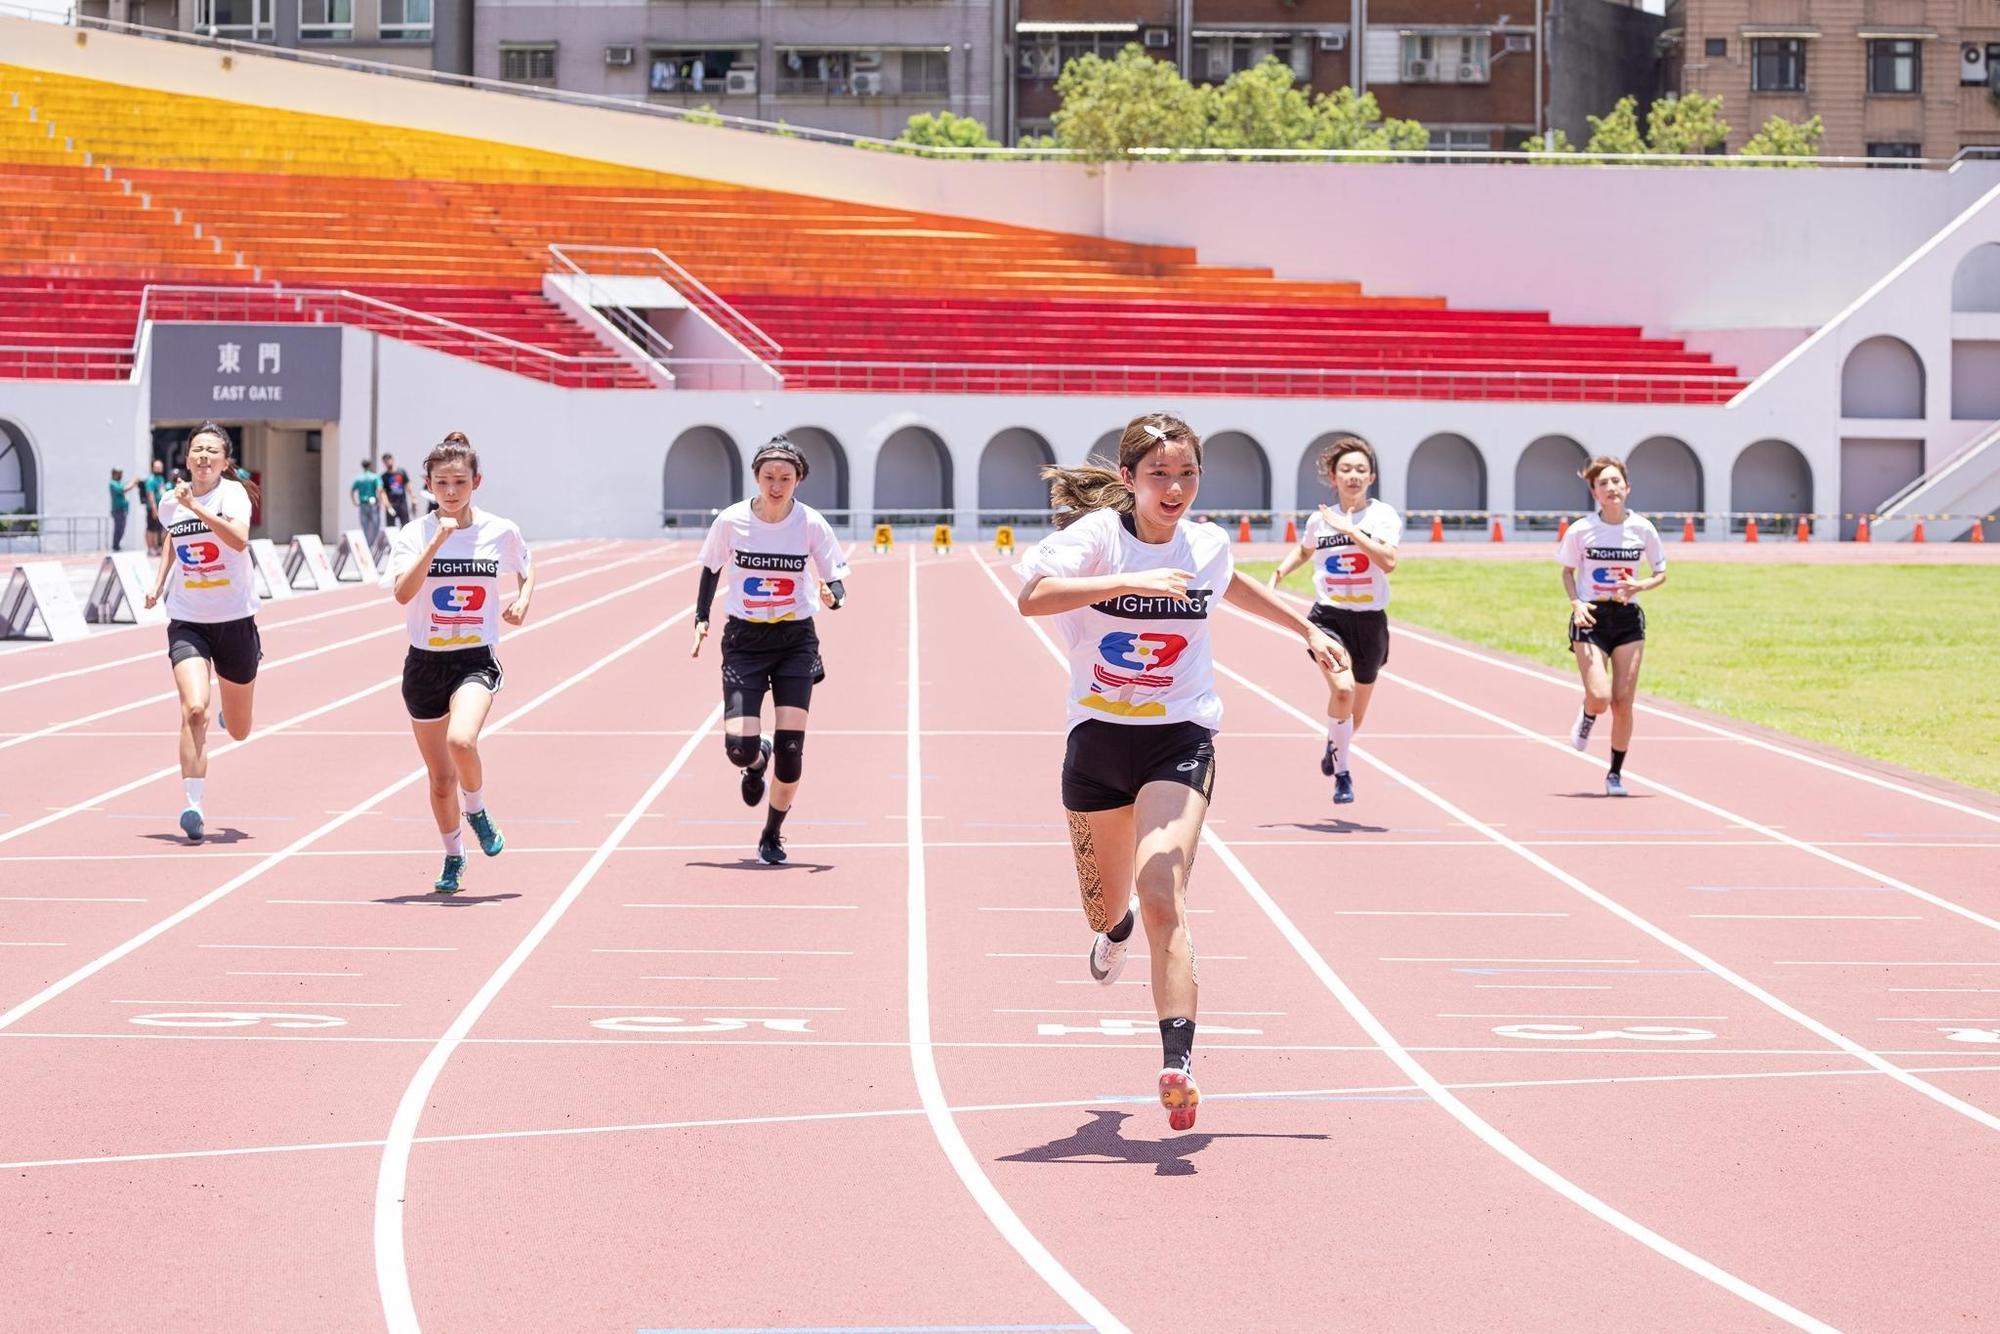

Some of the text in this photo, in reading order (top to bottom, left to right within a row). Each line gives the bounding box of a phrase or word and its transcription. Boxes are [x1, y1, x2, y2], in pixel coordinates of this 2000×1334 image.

[217, 342, 281, 374] 東門
[213, 385, 282, 401] EAST GATE
[878, 528, 889, 544] 5
[936, 529, 947, 545] 4
[1000, 530, 1011, 546] 3
[1591, 549, 1640, 559] FIGHTING
[429, 562, 496, 573] FIGHTING
[740, 556, 803, 569] FIGHTING
[589, 1016, 814, 1032] 5
[1492, 1024, 1717, 1041] 3
